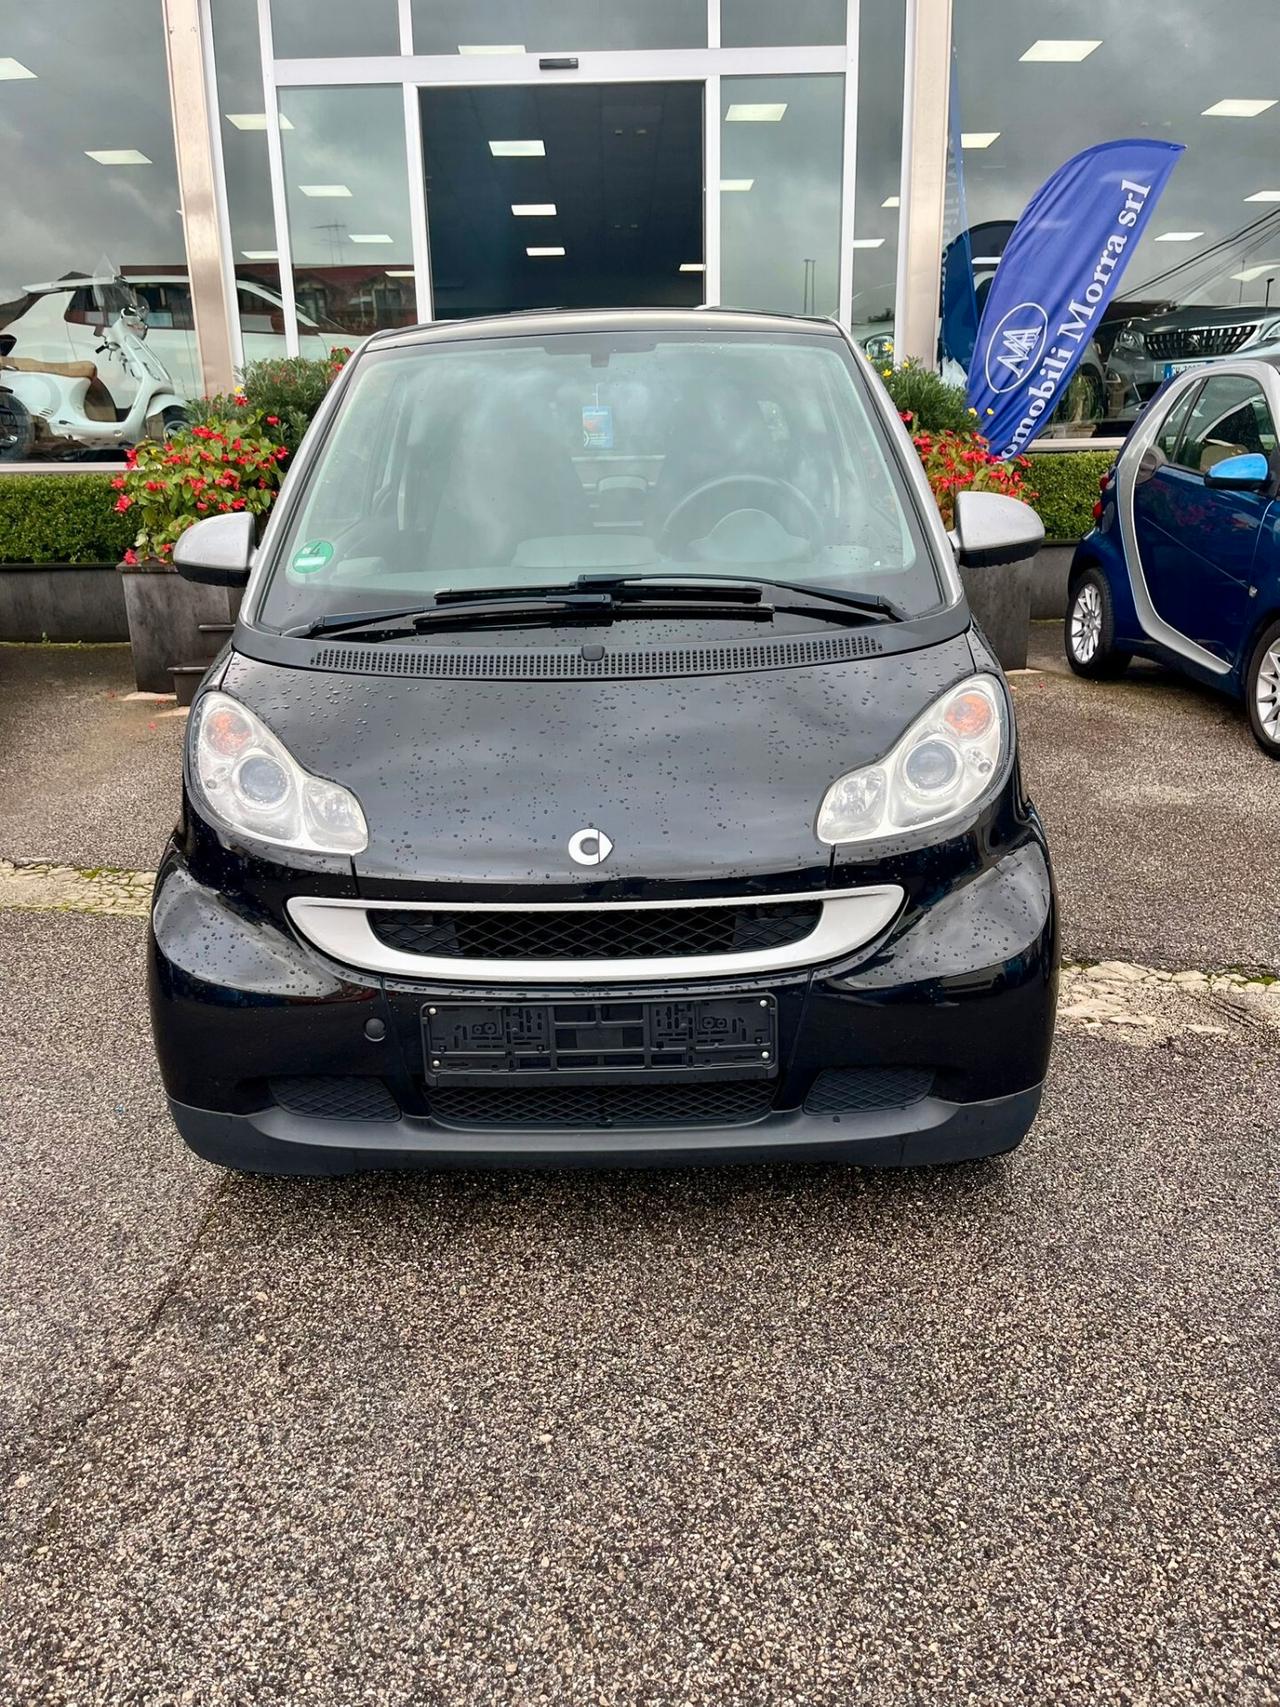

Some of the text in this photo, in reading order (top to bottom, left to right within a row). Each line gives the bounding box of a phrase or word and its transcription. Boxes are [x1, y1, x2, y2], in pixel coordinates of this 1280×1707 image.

[1056, 233, 1128, 343] Morra
[1119, 178, 1151, 228] srl
[309, 542, 322, 557] 4
